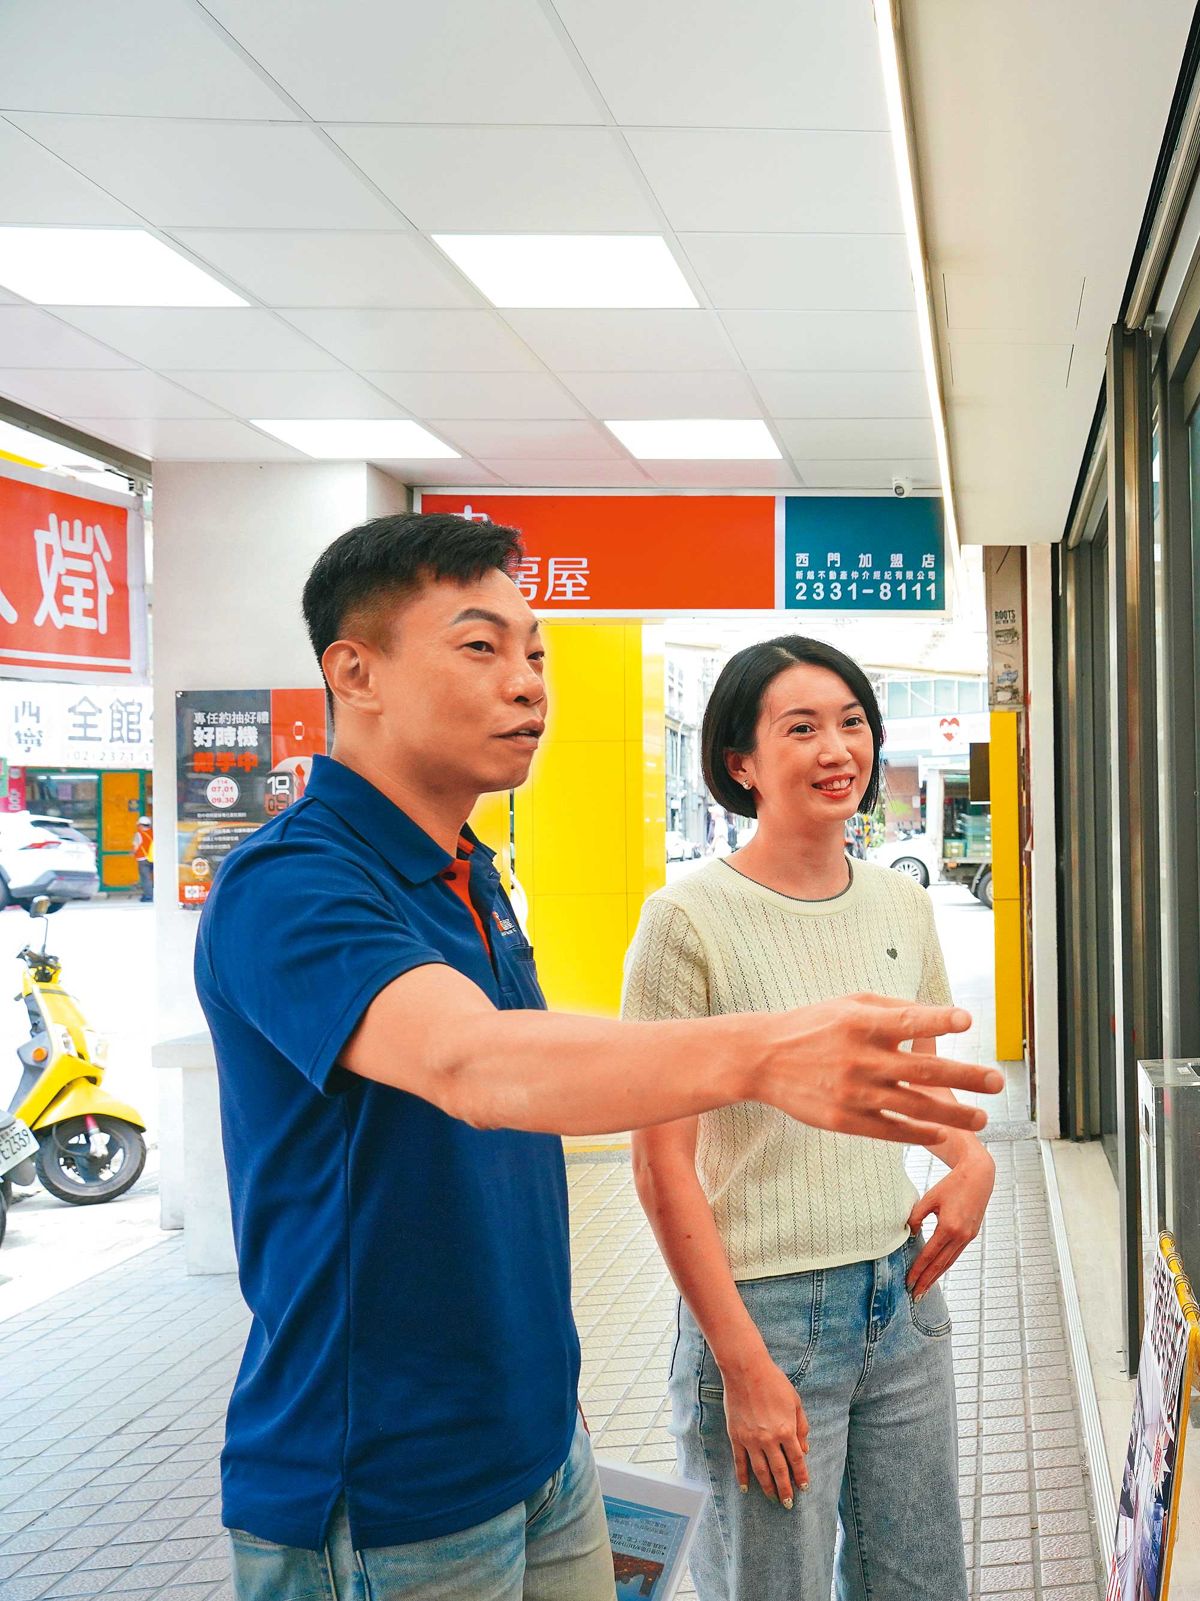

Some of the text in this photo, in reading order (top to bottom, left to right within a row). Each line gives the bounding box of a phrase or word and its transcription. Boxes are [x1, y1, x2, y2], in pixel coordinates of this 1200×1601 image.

[795, 552, 936, 568] 西門加盟店
[795, 582, 936, 601] 2331-8111
[67, 696, 153, 744] 全館
[193, 726, 259, 748] 好時機
